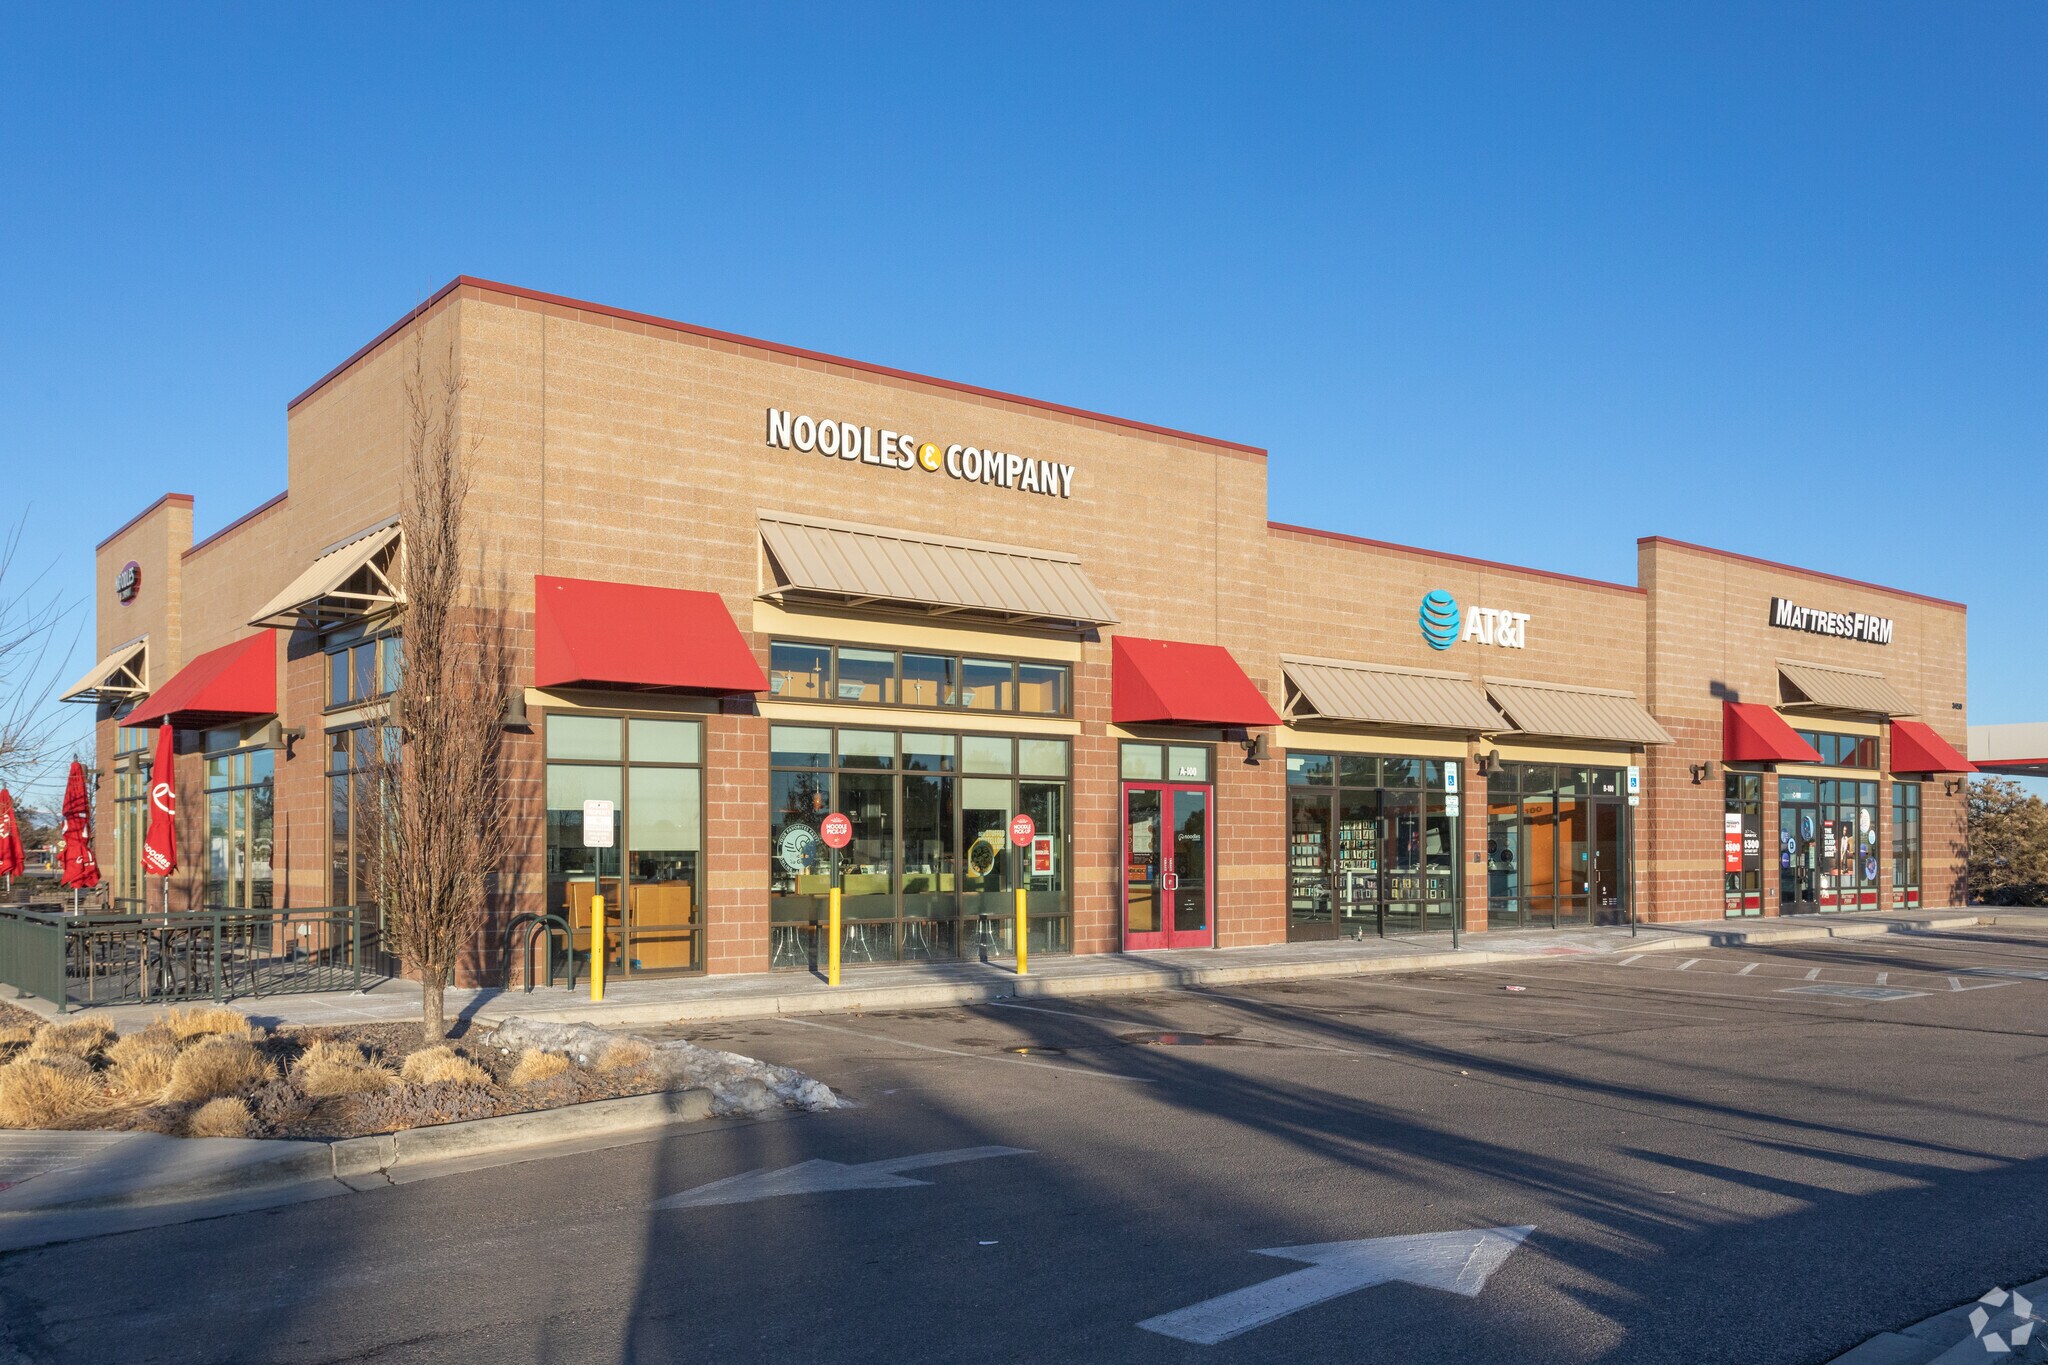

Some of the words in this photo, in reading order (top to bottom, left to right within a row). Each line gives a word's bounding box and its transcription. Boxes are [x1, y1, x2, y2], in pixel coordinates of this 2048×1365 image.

[767, 408, 914, 470] NOODLES
[944, 444, 1075, 498] COMPANY
[1461, 606, 1531, 650] AT&T
[1744, 839, 1760, 849] $300
